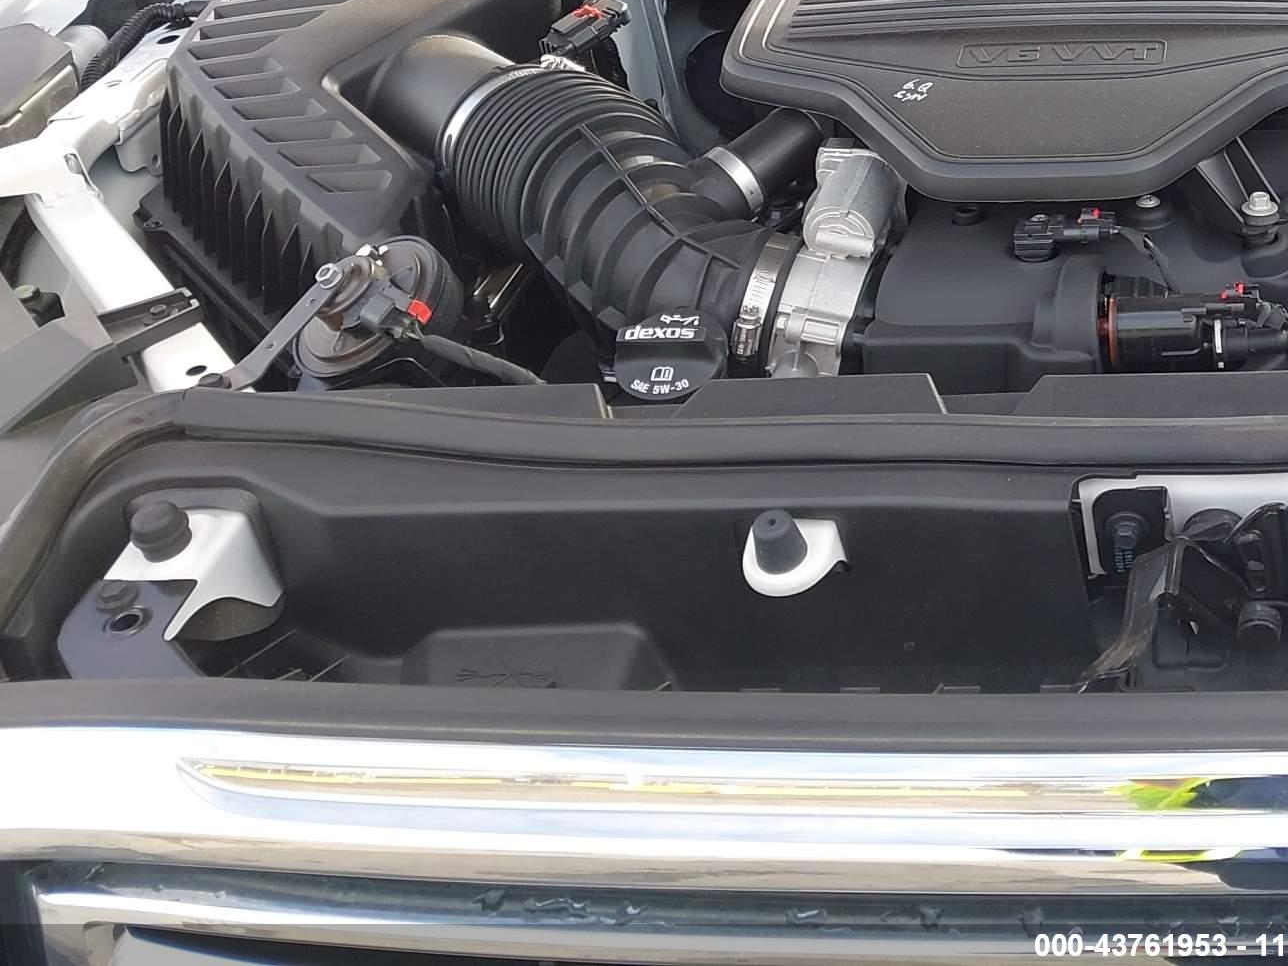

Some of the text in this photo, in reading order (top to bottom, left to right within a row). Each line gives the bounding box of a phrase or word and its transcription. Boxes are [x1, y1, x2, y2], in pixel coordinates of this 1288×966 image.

[968, 43, 1158, 63] V6 VVT
[624, 325, 699, 340] dexos
[630, 378, 690, 395] SAE 5W-30
